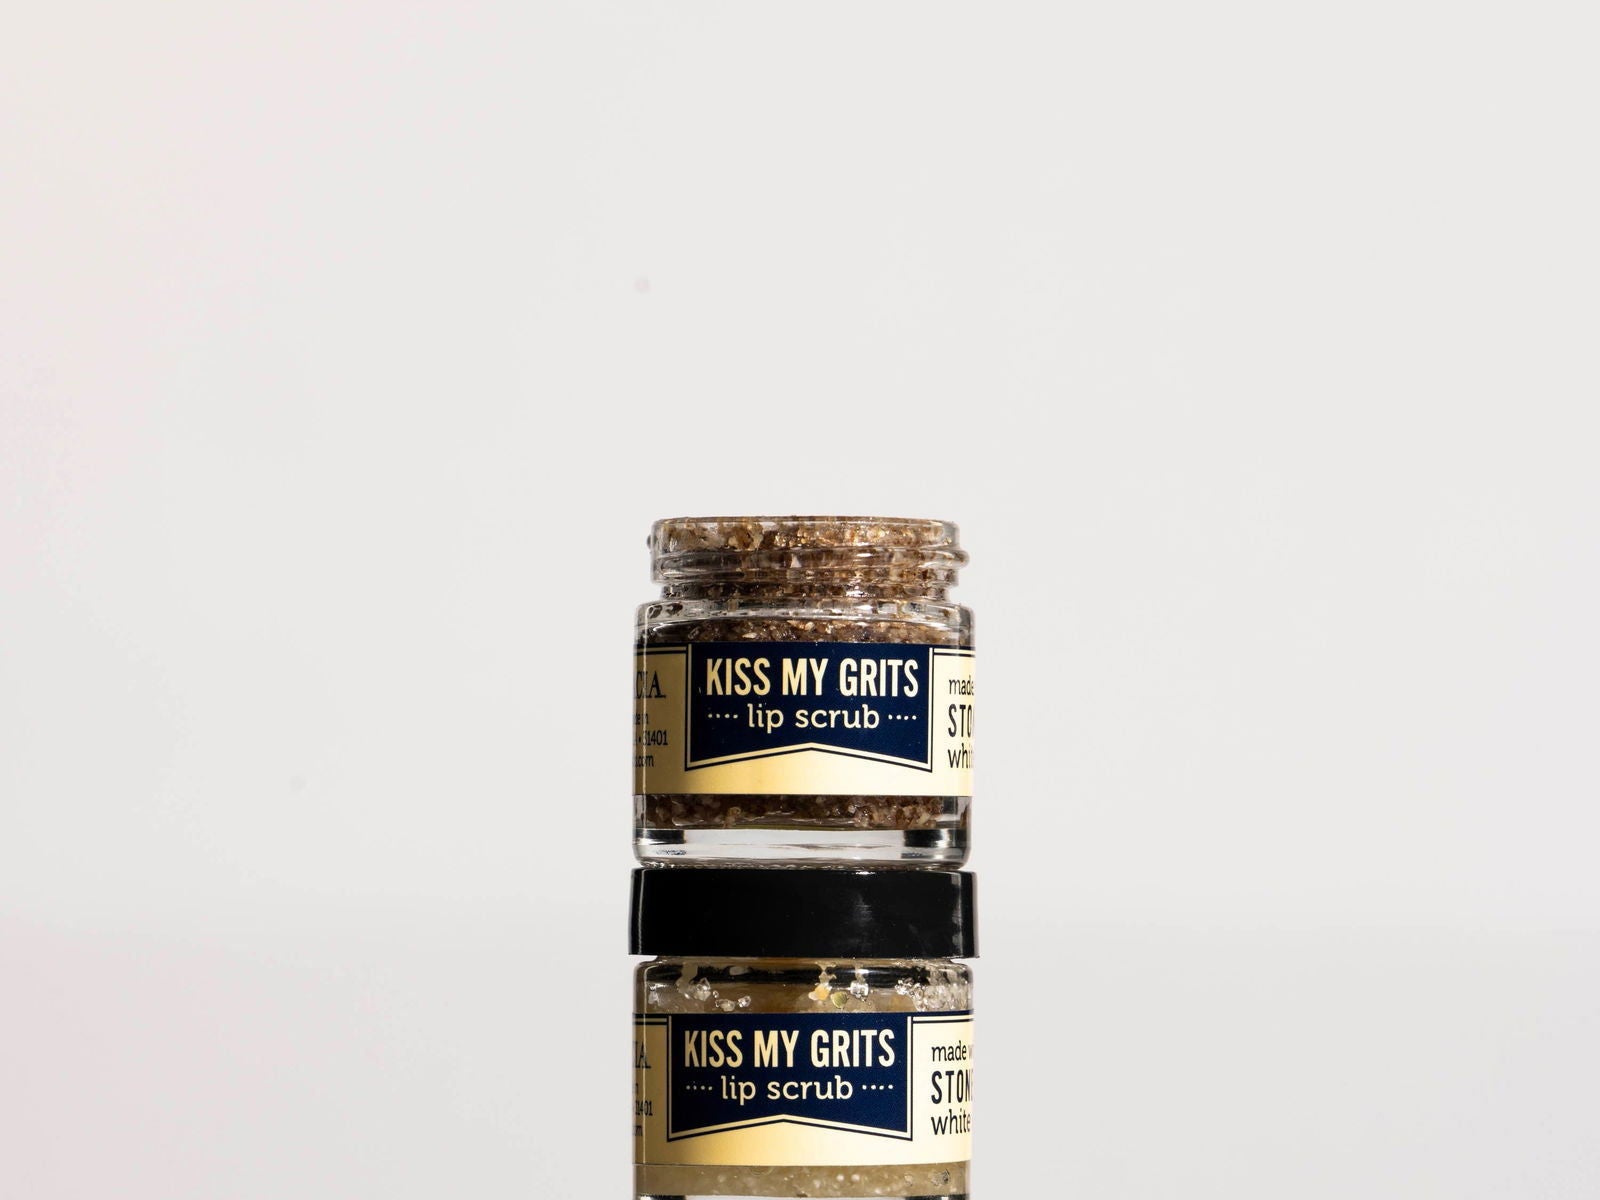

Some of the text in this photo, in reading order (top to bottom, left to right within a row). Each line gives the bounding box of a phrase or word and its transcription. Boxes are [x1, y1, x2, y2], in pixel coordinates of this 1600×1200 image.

[706, 657, 919, 698] KISS MY GRITS
[747, 703, 880, 734] lip scrub
[684, 1029, 895, 1069] KISS MY GRITS
[931, 1040, 967, 1062] made
[720, 1074, 853, 1106] lip scrub
[930, 1107, 971, 1136] white
